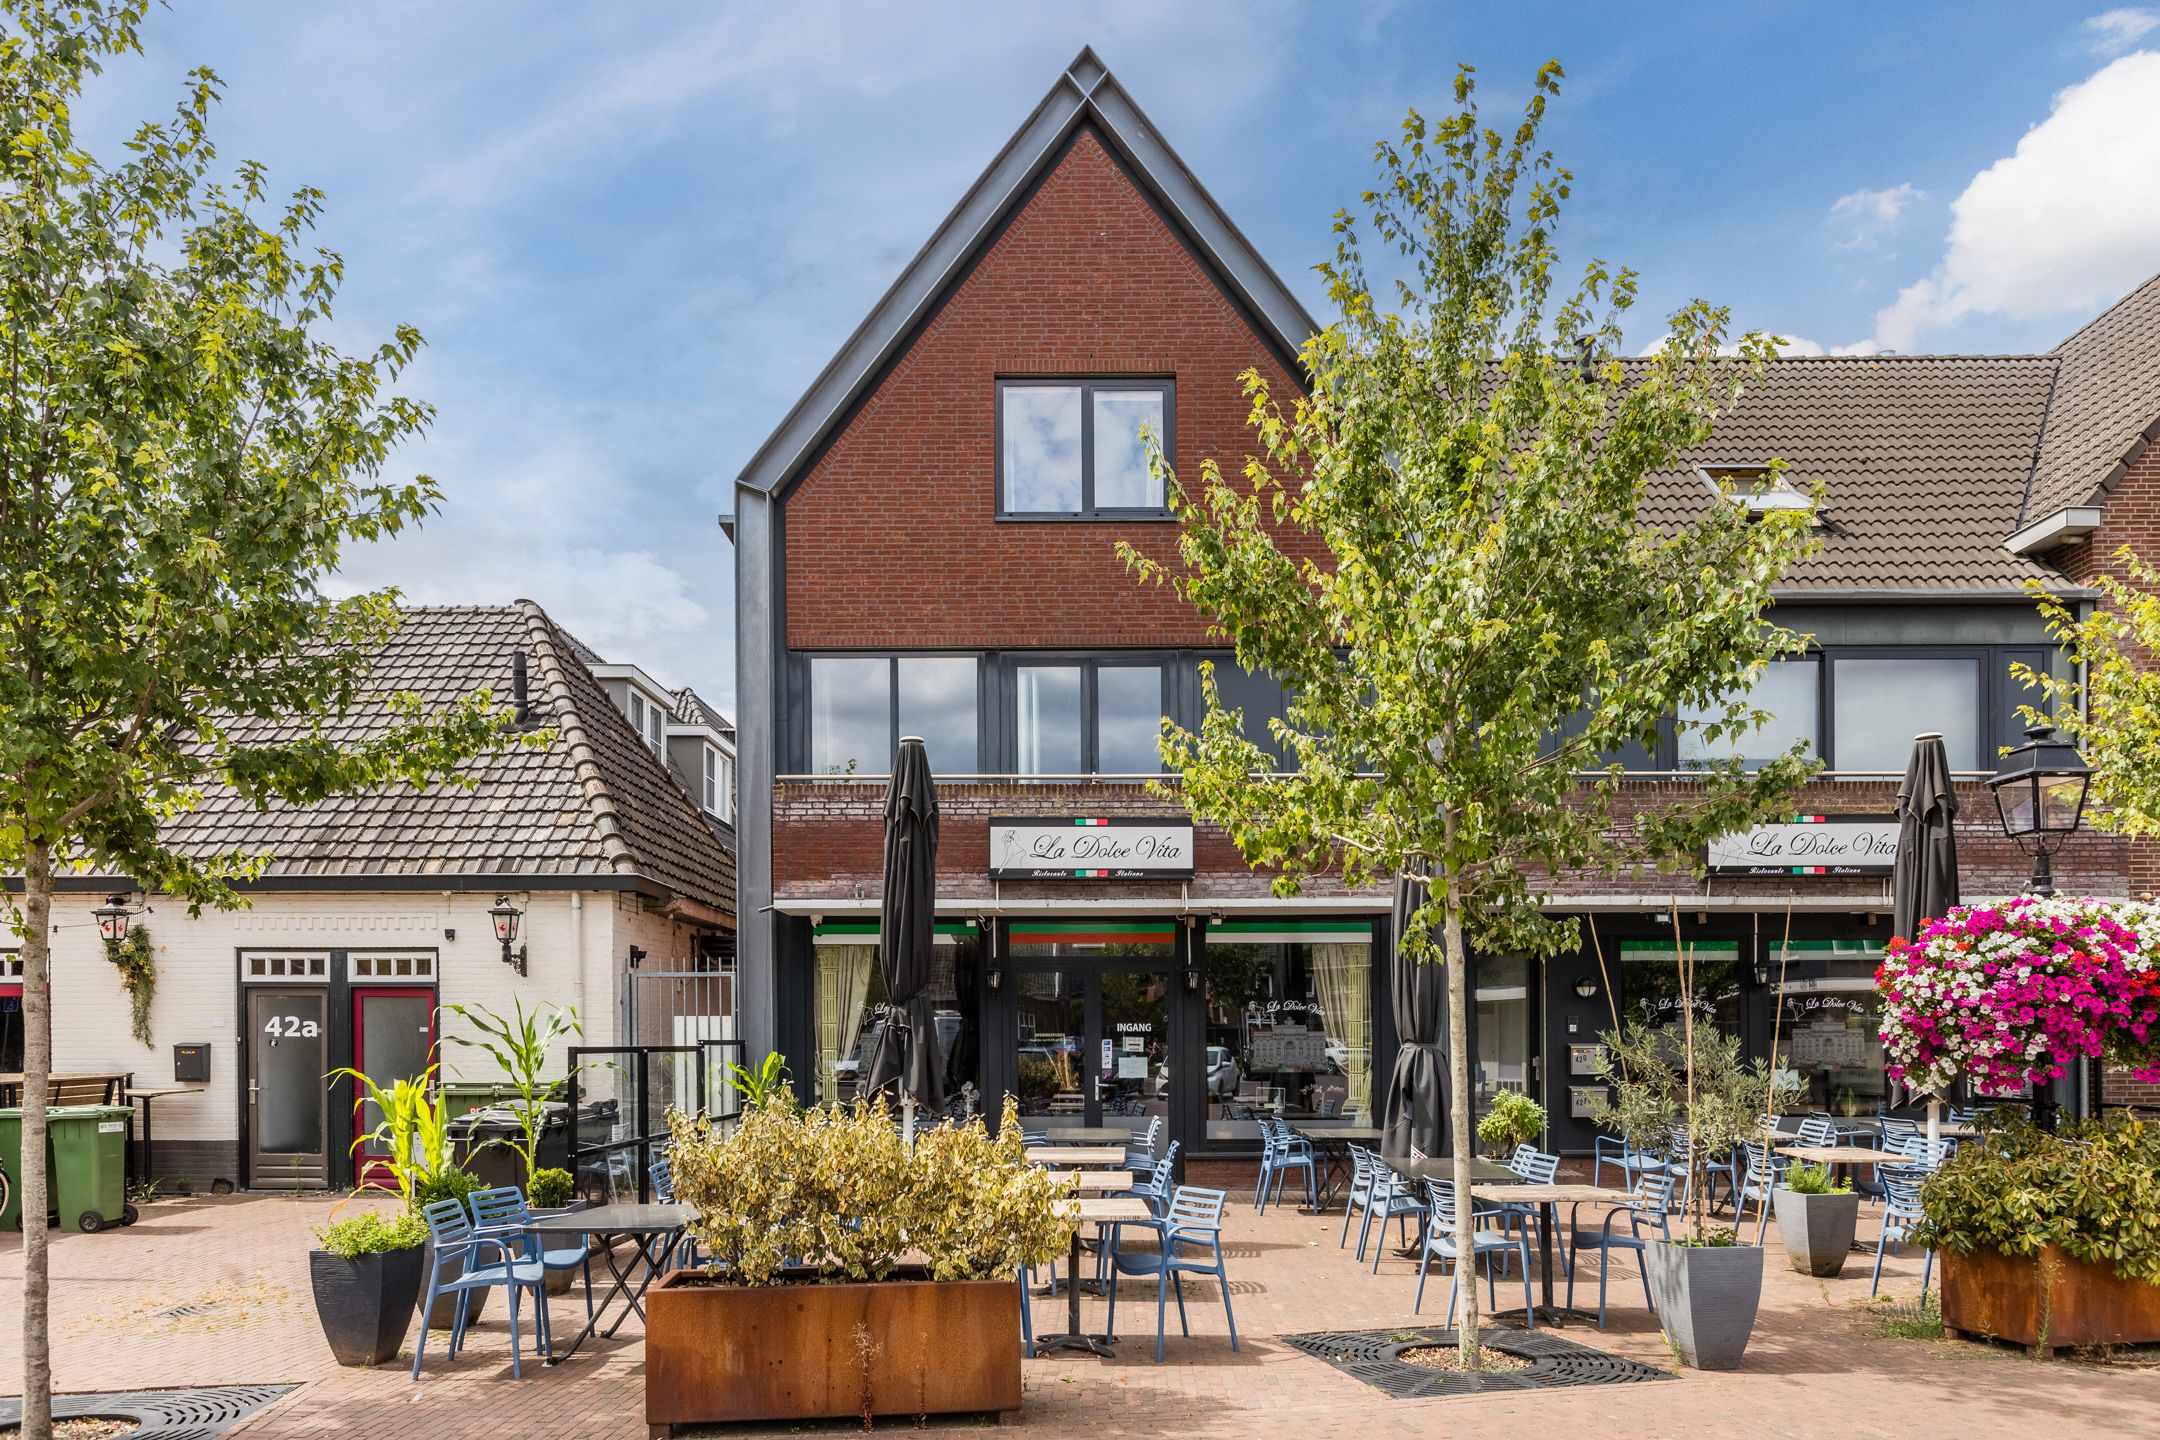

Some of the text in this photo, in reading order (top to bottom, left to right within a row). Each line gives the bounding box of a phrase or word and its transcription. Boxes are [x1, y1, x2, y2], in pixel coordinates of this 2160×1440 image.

[1030, 835, 1181, 859] La Dolce Vita
[1747, 832, 1896, 856] La Dolce Vita
[1267, 1000, 1325, 1016] La Dolce Vita
[1806, 997, 1864, 1013] La Dolce Vita
[265, 1016, 318, 1037] 42a
[1117, 1023, 1151, 1032] INGANG
